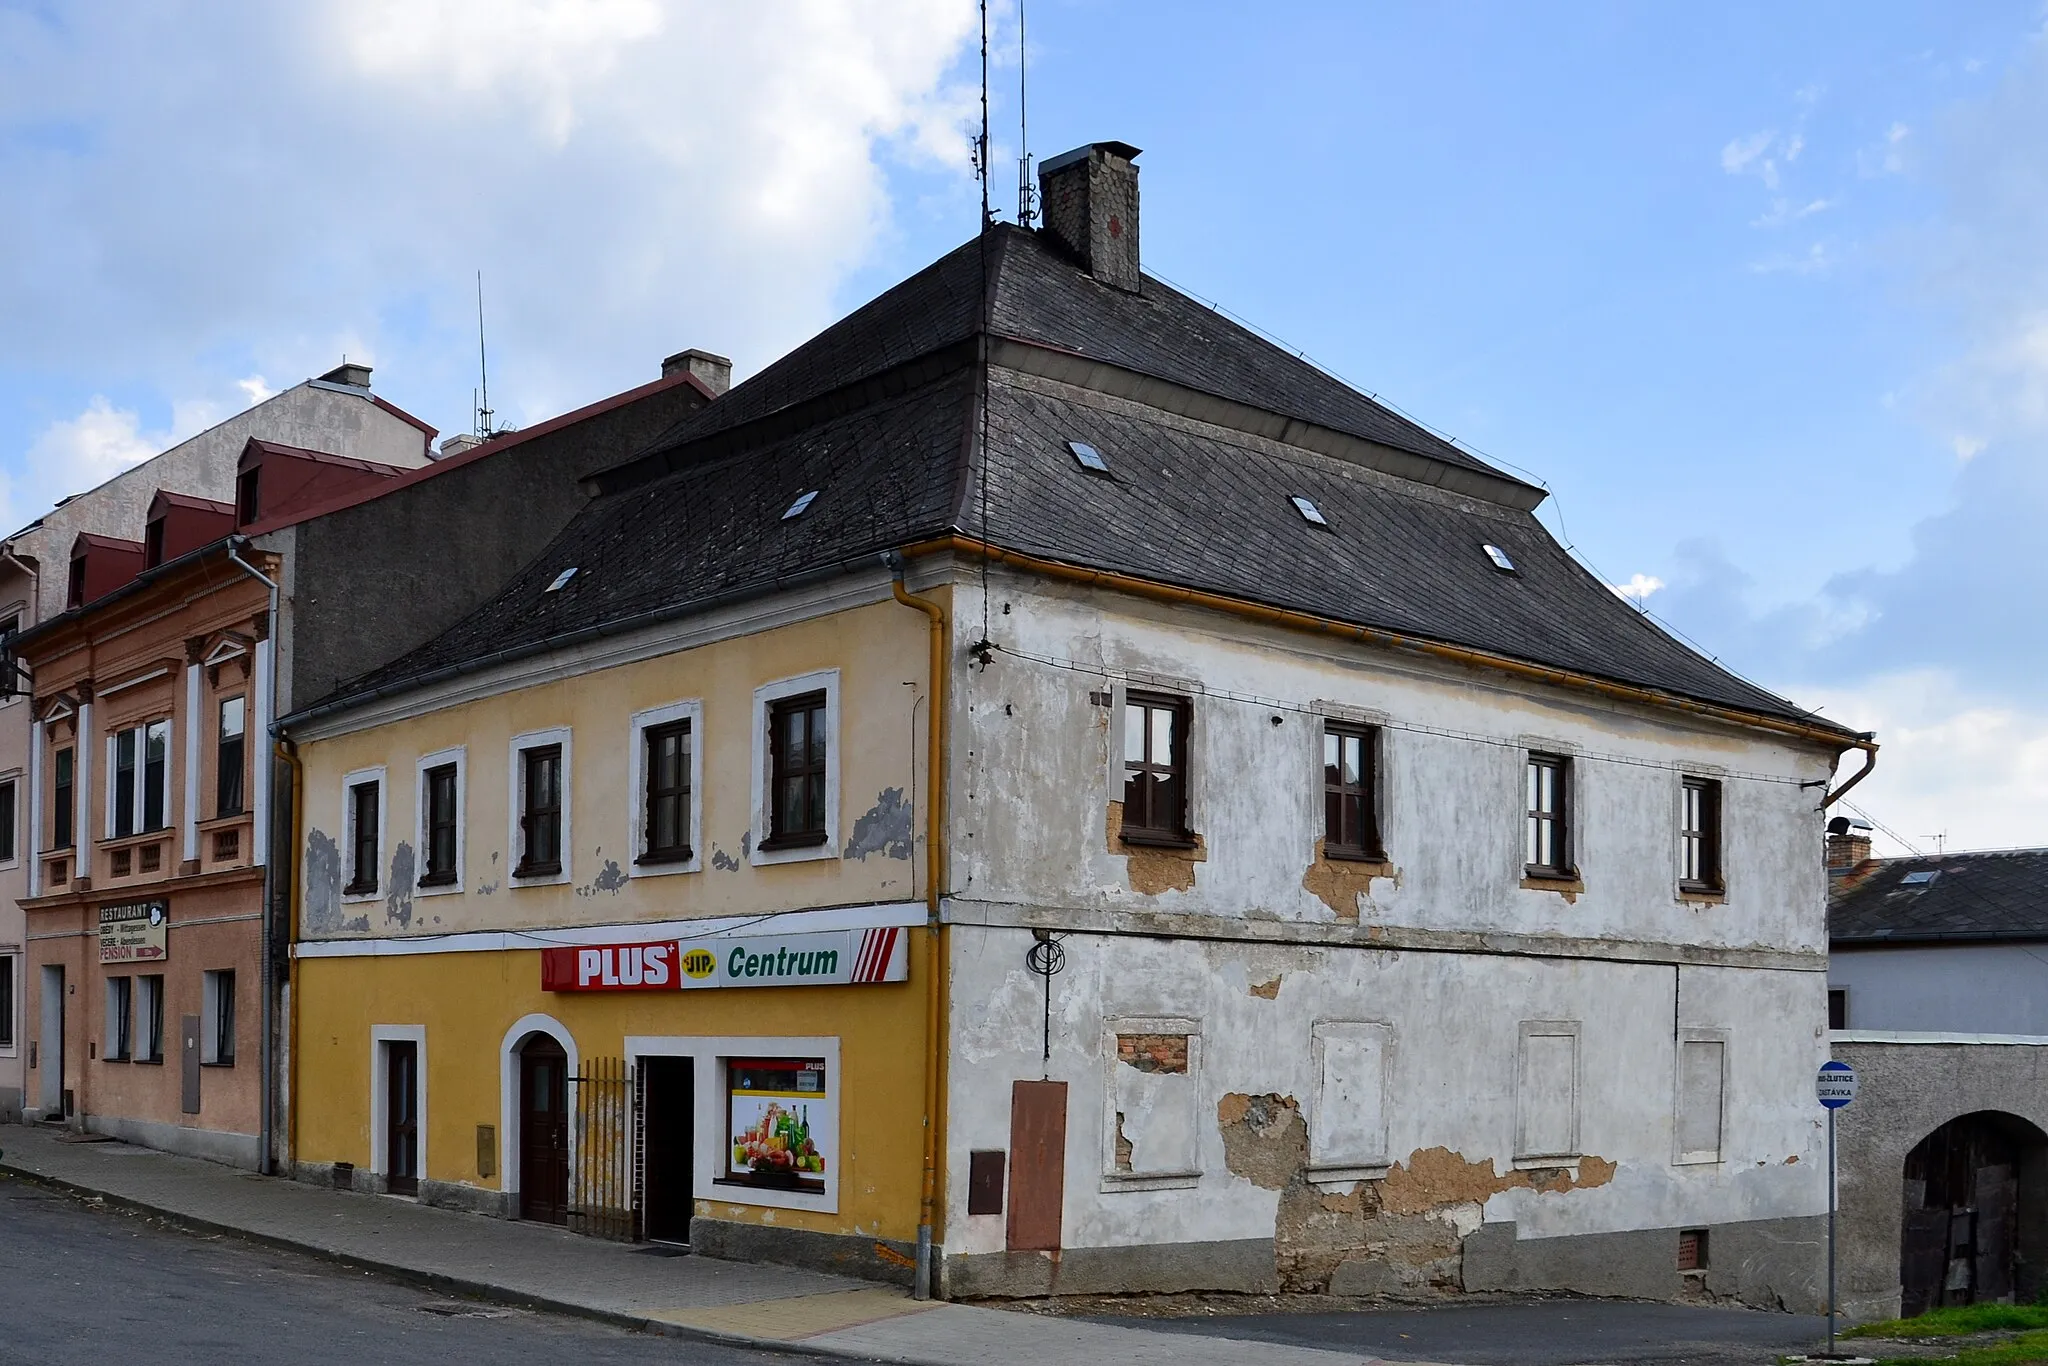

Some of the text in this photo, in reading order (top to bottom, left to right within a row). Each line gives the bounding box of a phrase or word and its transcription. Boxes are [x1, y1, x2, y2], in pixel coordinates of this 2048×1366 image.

[100, 904, 147, 921] RESTAURANT
[100, 946, 132, 960] PENSION
[687, 955, 711, 973] JIP
[727, 946, 838, 978] Centrum
[805, 1062, 825, 1071] PLUS
